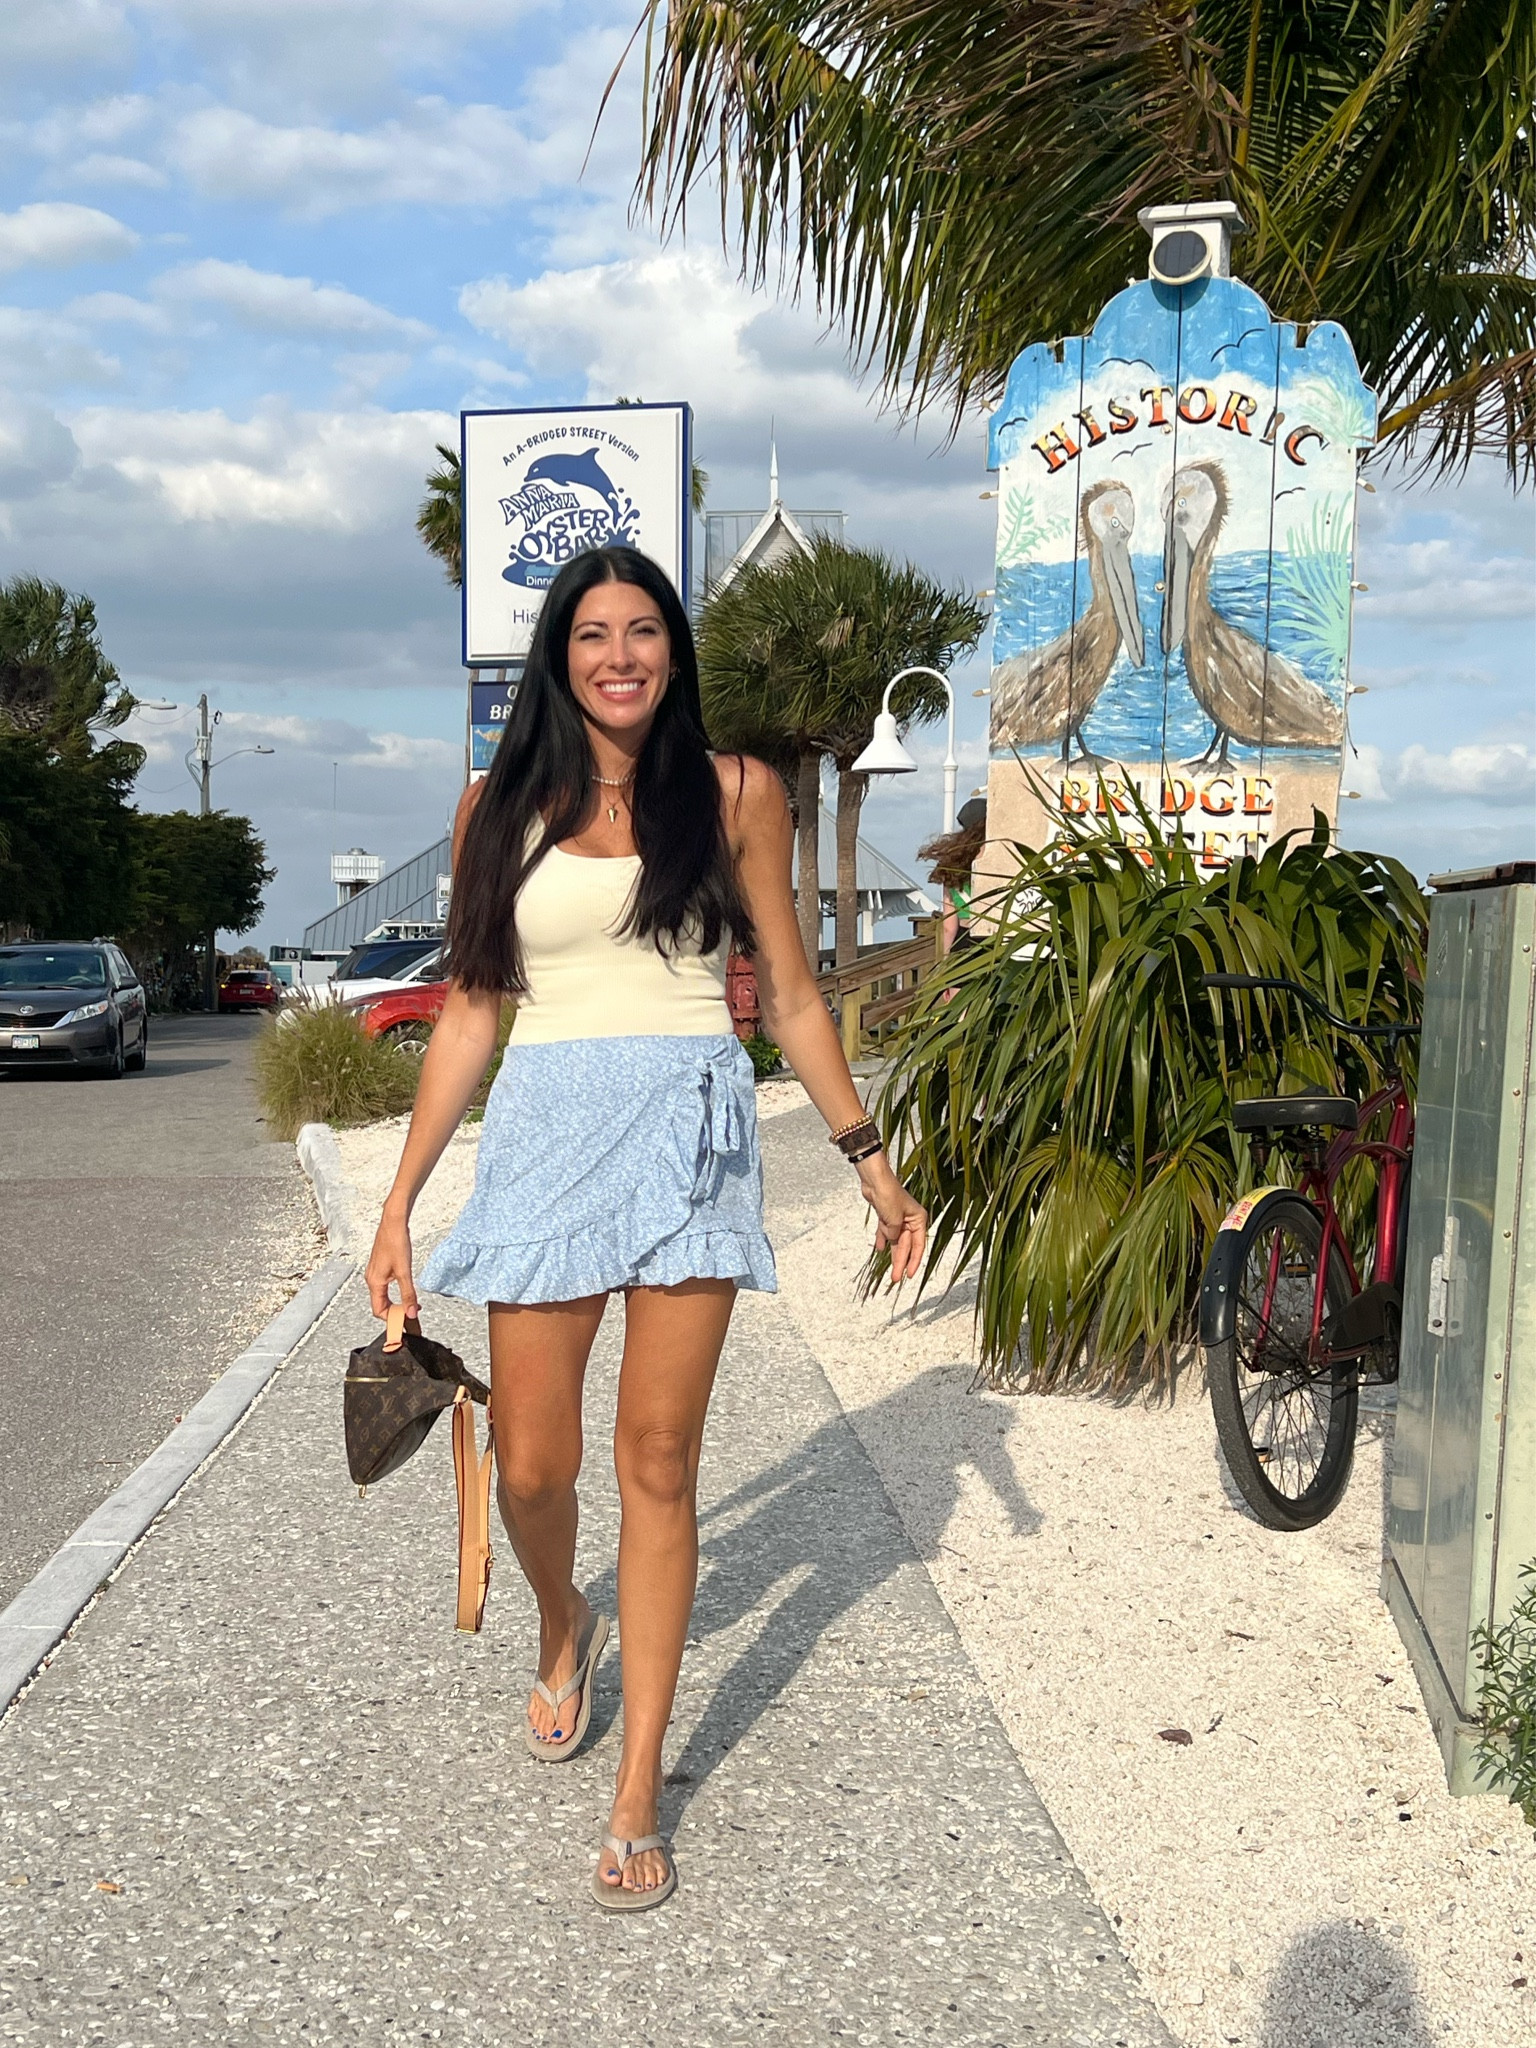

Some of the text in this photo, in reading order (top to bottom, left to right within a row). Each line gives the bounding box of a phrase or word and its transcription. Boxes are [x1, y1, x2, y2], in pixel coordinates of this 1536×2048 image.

[502, 426, 640, 467] An A-BRIDGED STREET Version
[1030, 385, 1330, 475] HISTORIC
[498, 484, 556, 526] ANNA
[520, 493, 581, 532] MARIA
[517, 509, 610, 560] OYSTER
[552, 526, 609, 563] BAR
[1060, 775, 1275, 817] BRIDGE
